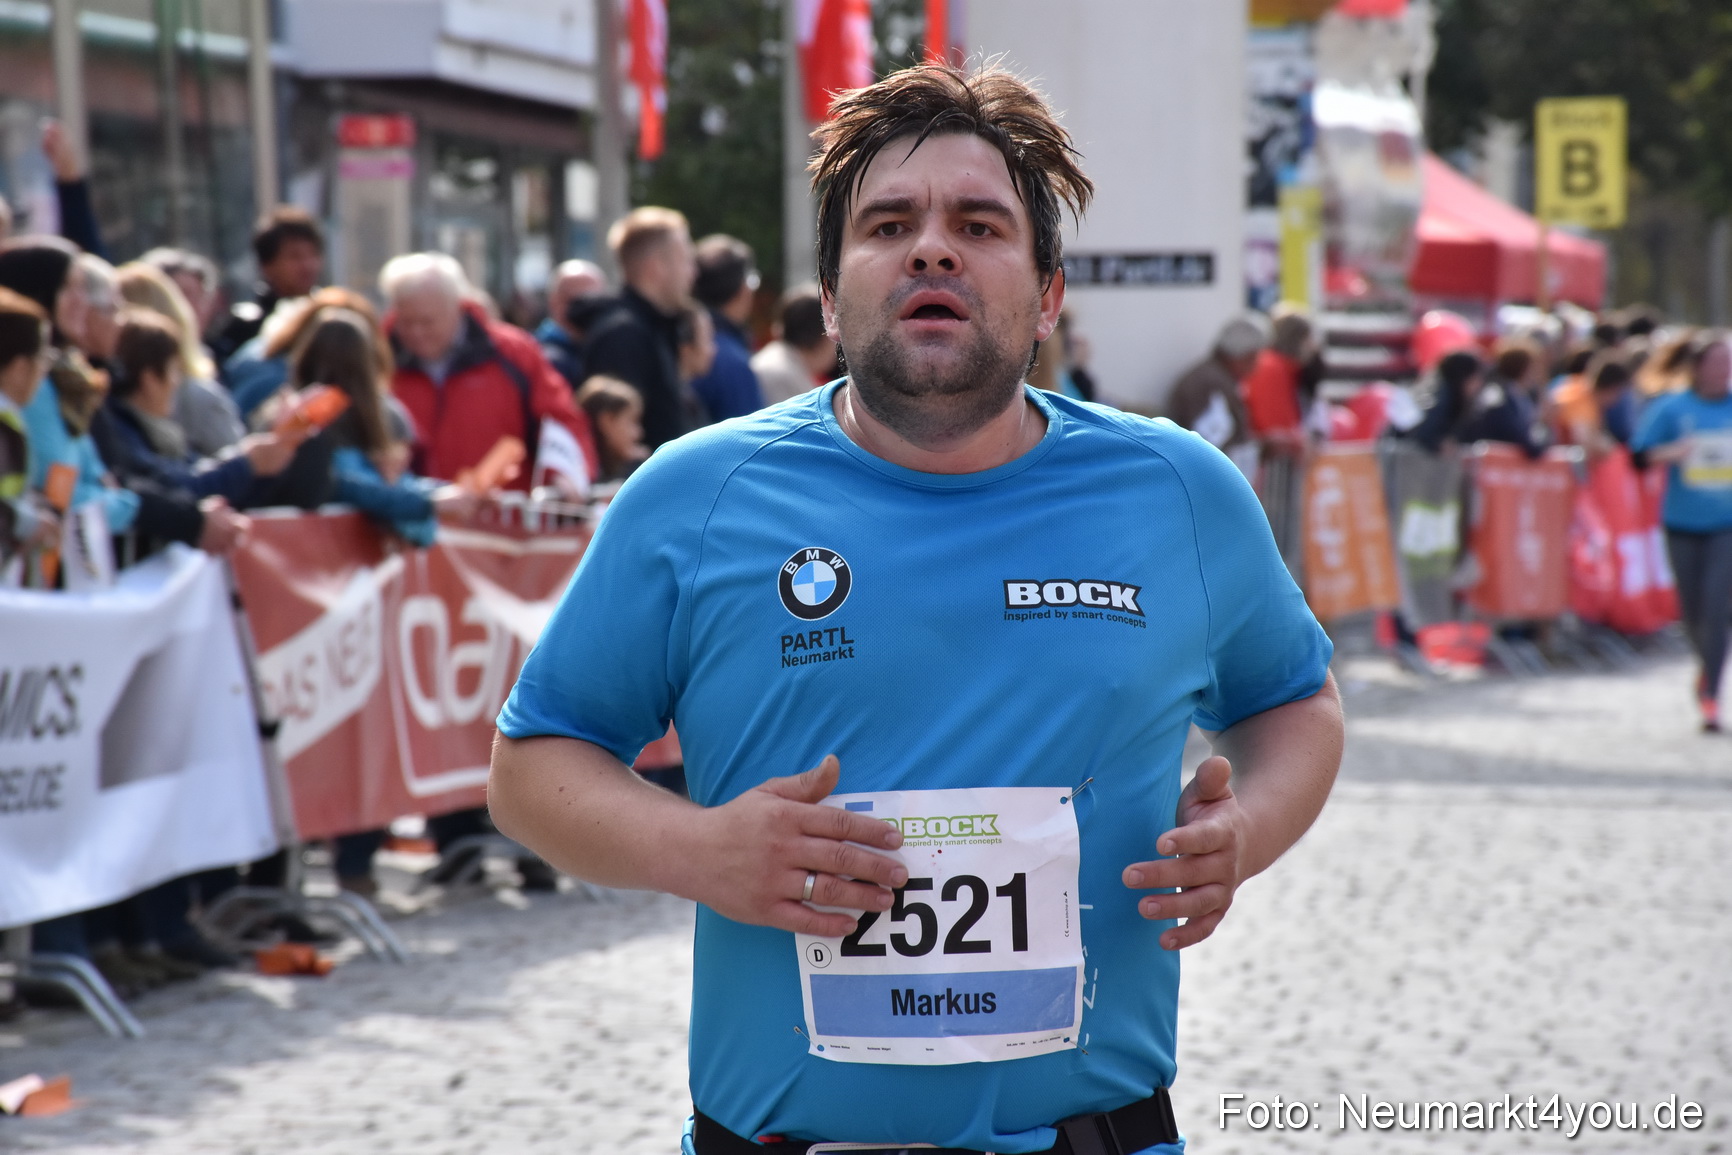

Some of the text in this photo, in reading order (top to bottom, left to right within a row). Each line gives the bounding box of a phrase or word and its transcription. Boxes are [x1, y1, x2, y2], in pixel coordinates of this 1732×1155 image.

[1560, 139, 1602, 198] B
[784, 549, 845, 575] BMW
[1005, 580, 1142, 614] BOCK
[1004, 609, 1147, 629] inspired by smart concepts
[780, 627, 855, 654] PARTL
[781, 646, 855, 669] Neumarkt
[902, 815, 998, 837] BOCK
[933, 838, 943, 848] by
[944, 838, 967, 846] smart
[969, 837, 1002, 846] concepts
[841, 873, 1028, 957] 2521
[814, 949, 824, 963] D
[891, 988, 997, 1017] Markus
